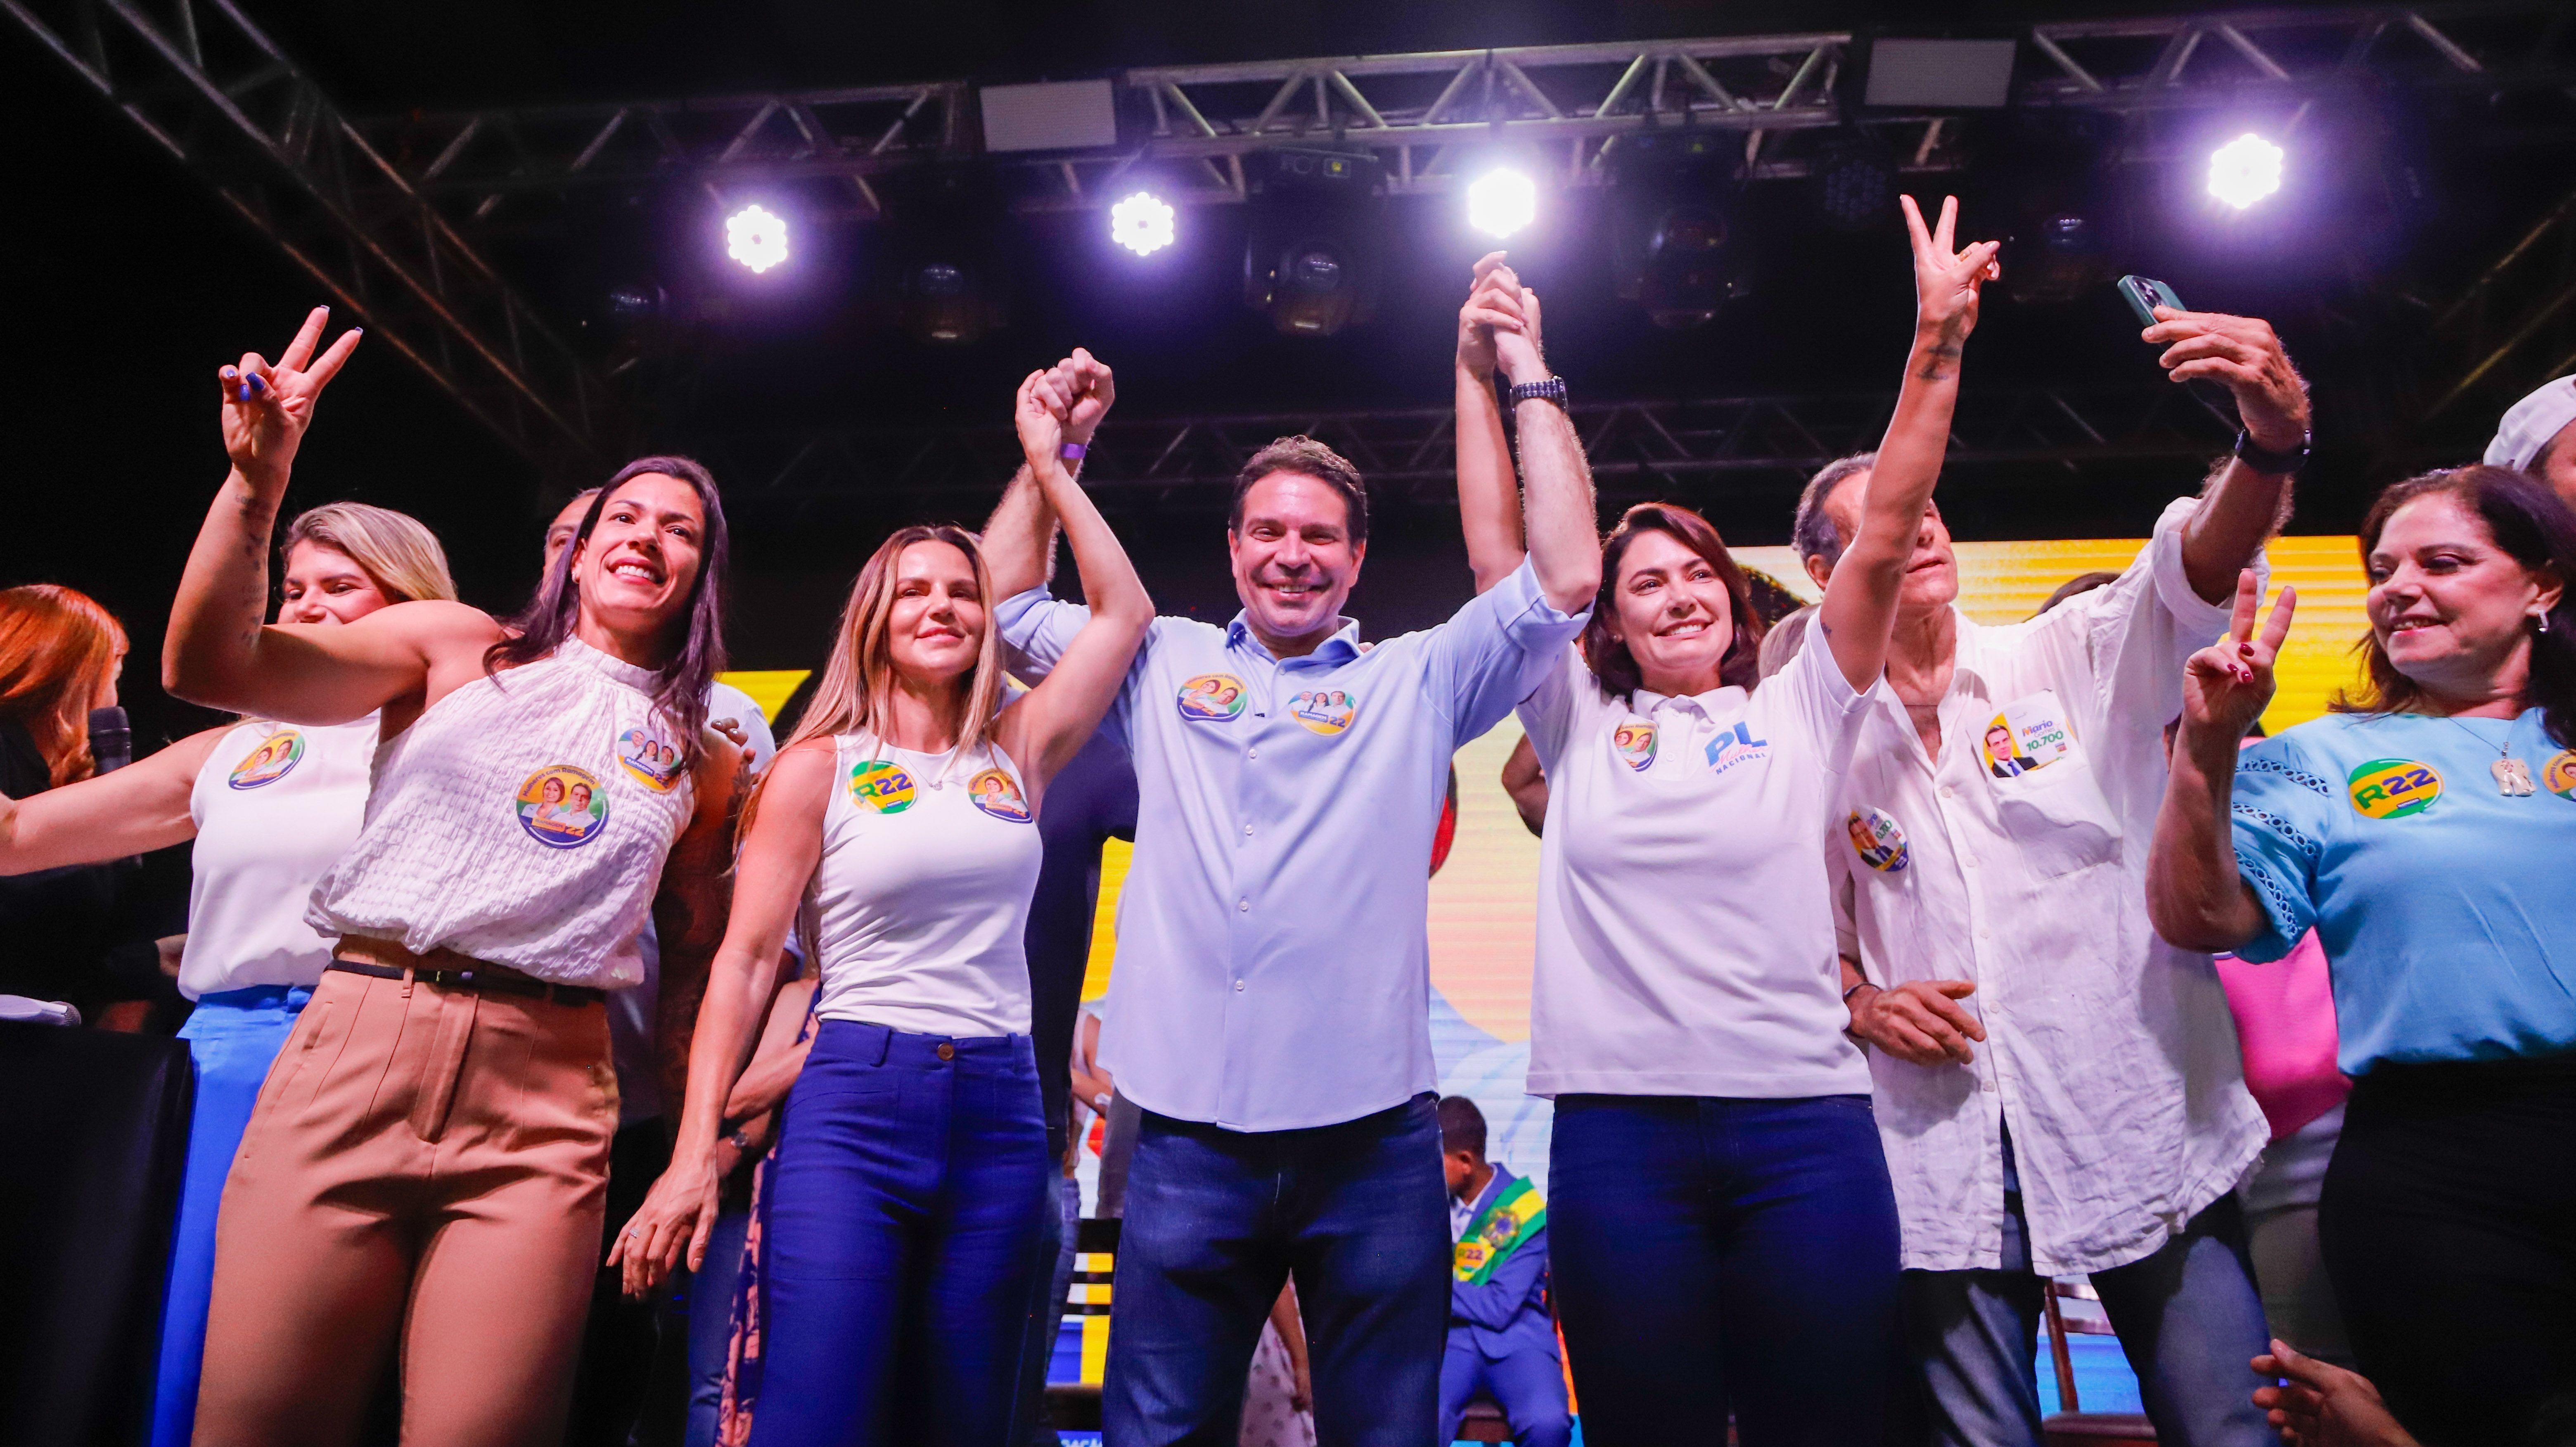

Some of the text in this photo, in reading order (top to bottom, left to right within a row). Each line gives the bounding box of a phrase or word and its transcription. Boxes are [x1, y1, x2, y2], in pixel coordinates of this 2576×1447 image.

[1329, 716, 1346, 727] 22
[2022, 720, 2053, 737] Mario
[2034, 728, 2055, 738] Gomes
[1704, 721, 1768, 767] PL
[2026, 731, 2064, 751] 10.700
[1716, 752, 1767, 775] NACIONAL
[522, 773, 545, 796] Mulheres
[562, 767, 595, 785] Ramagem
[853, 773, 913, 803] R22
[2355, 769, 2437, 809] R22
